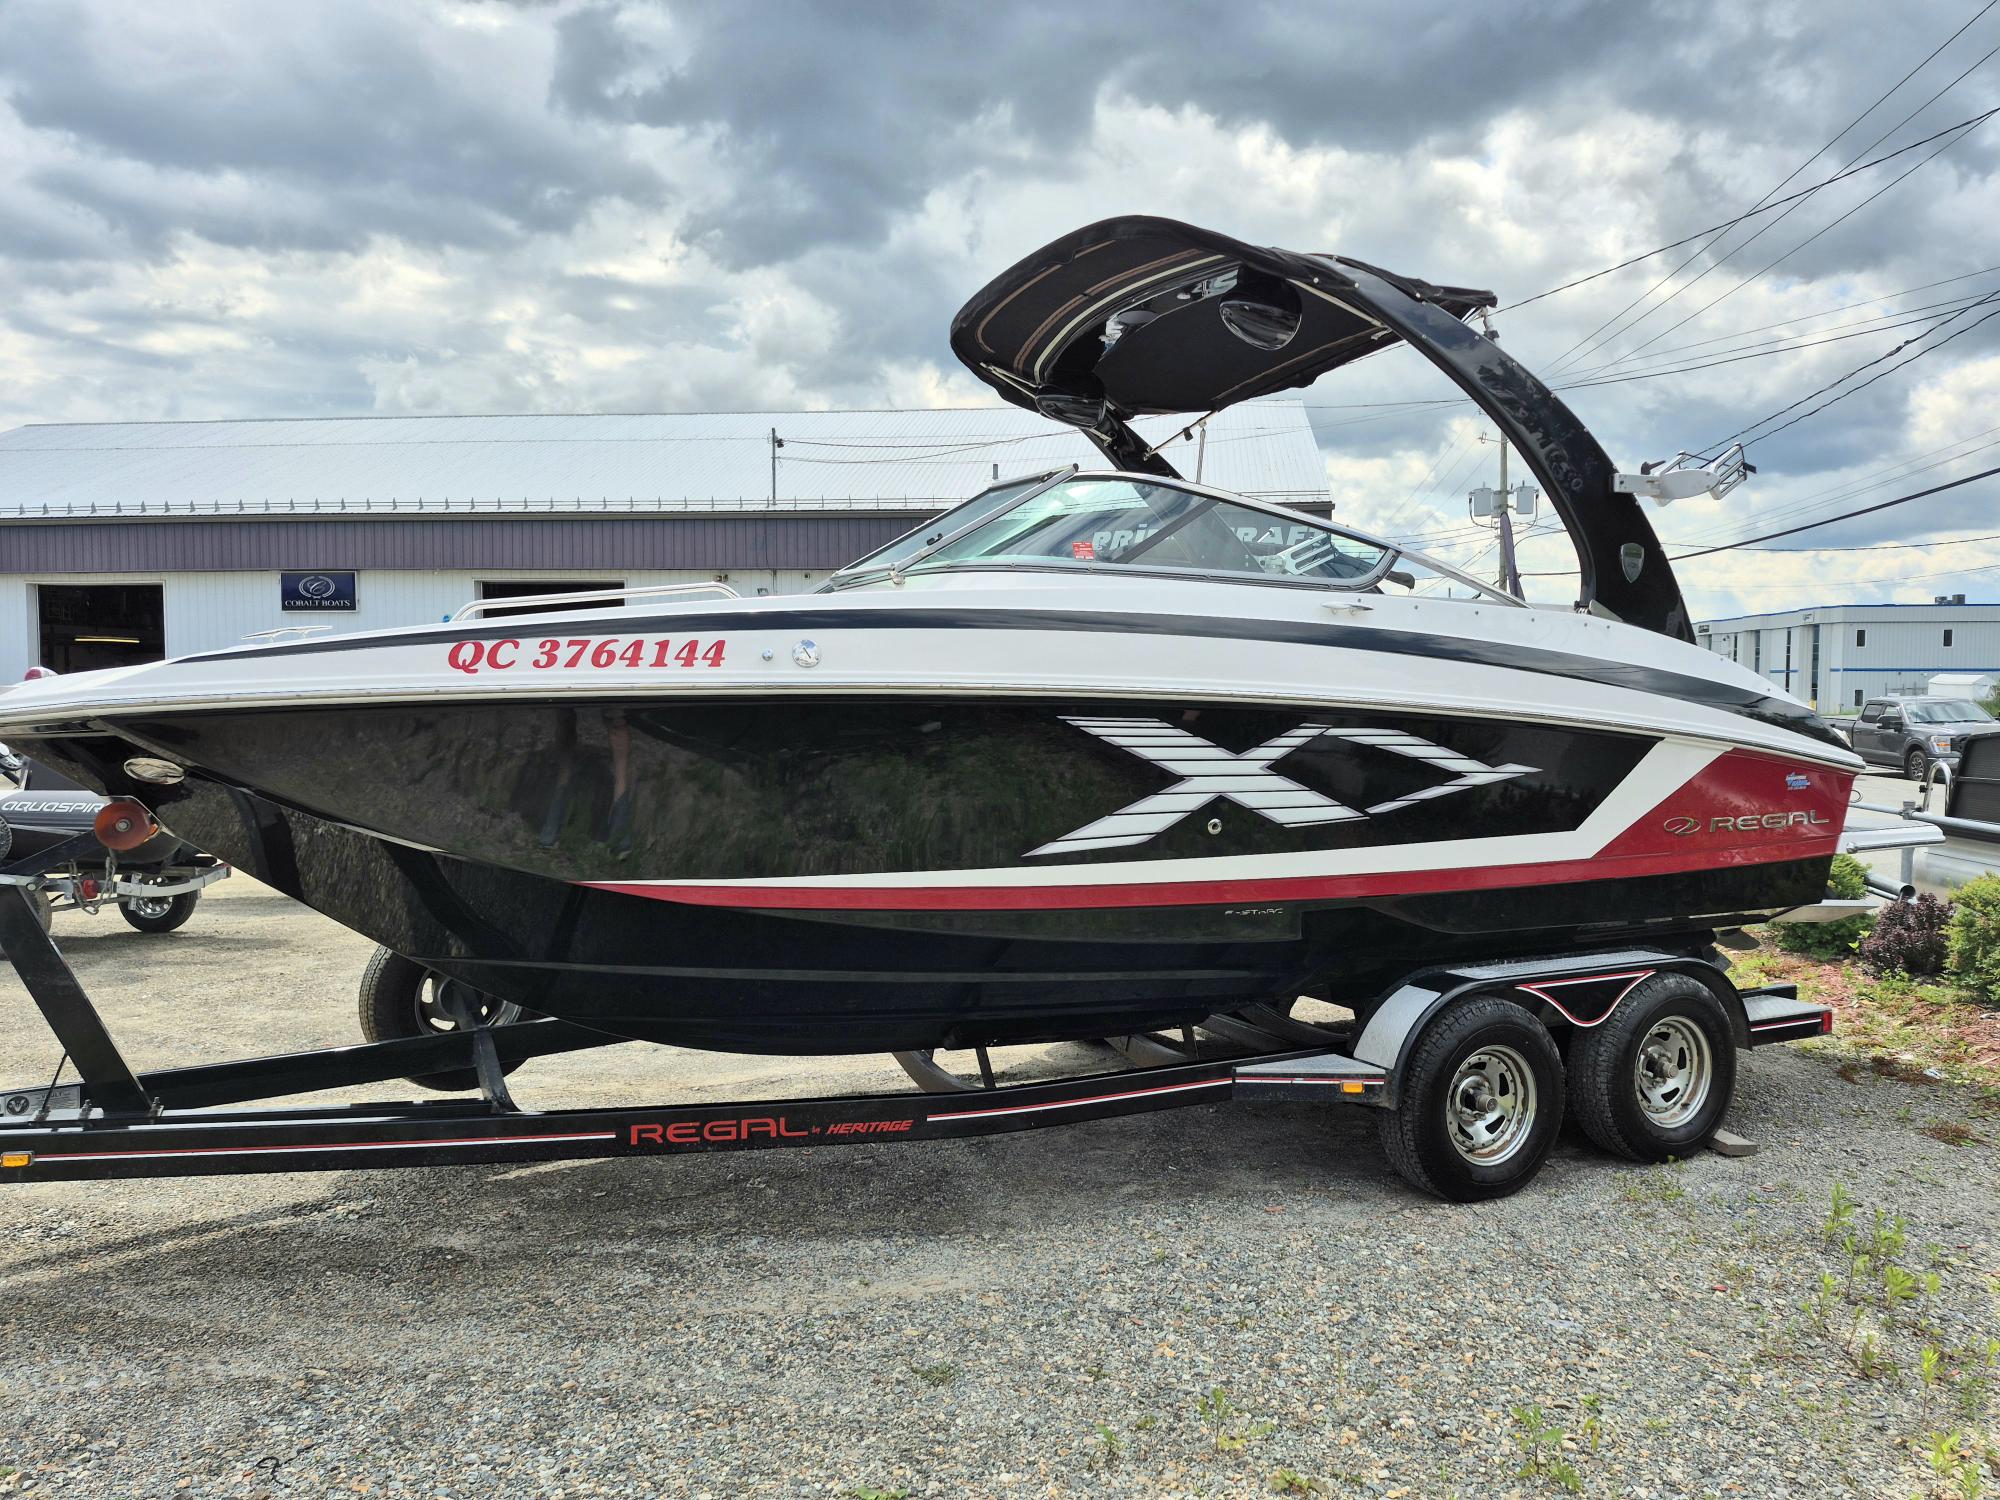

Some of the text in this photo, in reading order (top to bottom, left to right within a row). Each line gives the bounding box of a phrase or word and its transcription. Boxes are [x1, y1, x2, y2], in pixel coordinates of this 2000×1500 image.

[284, 599, 351, 607] COBALT BOATS
[448, 639, 726, 674] QC 3764144
[1, 801, 105, 813] AQUASPIR
[1709, 809, 1829, 833] REGAL
[630, 1117, 808, 1145] REGAL
[826, 1120, 914, 1135] HERITAGE
